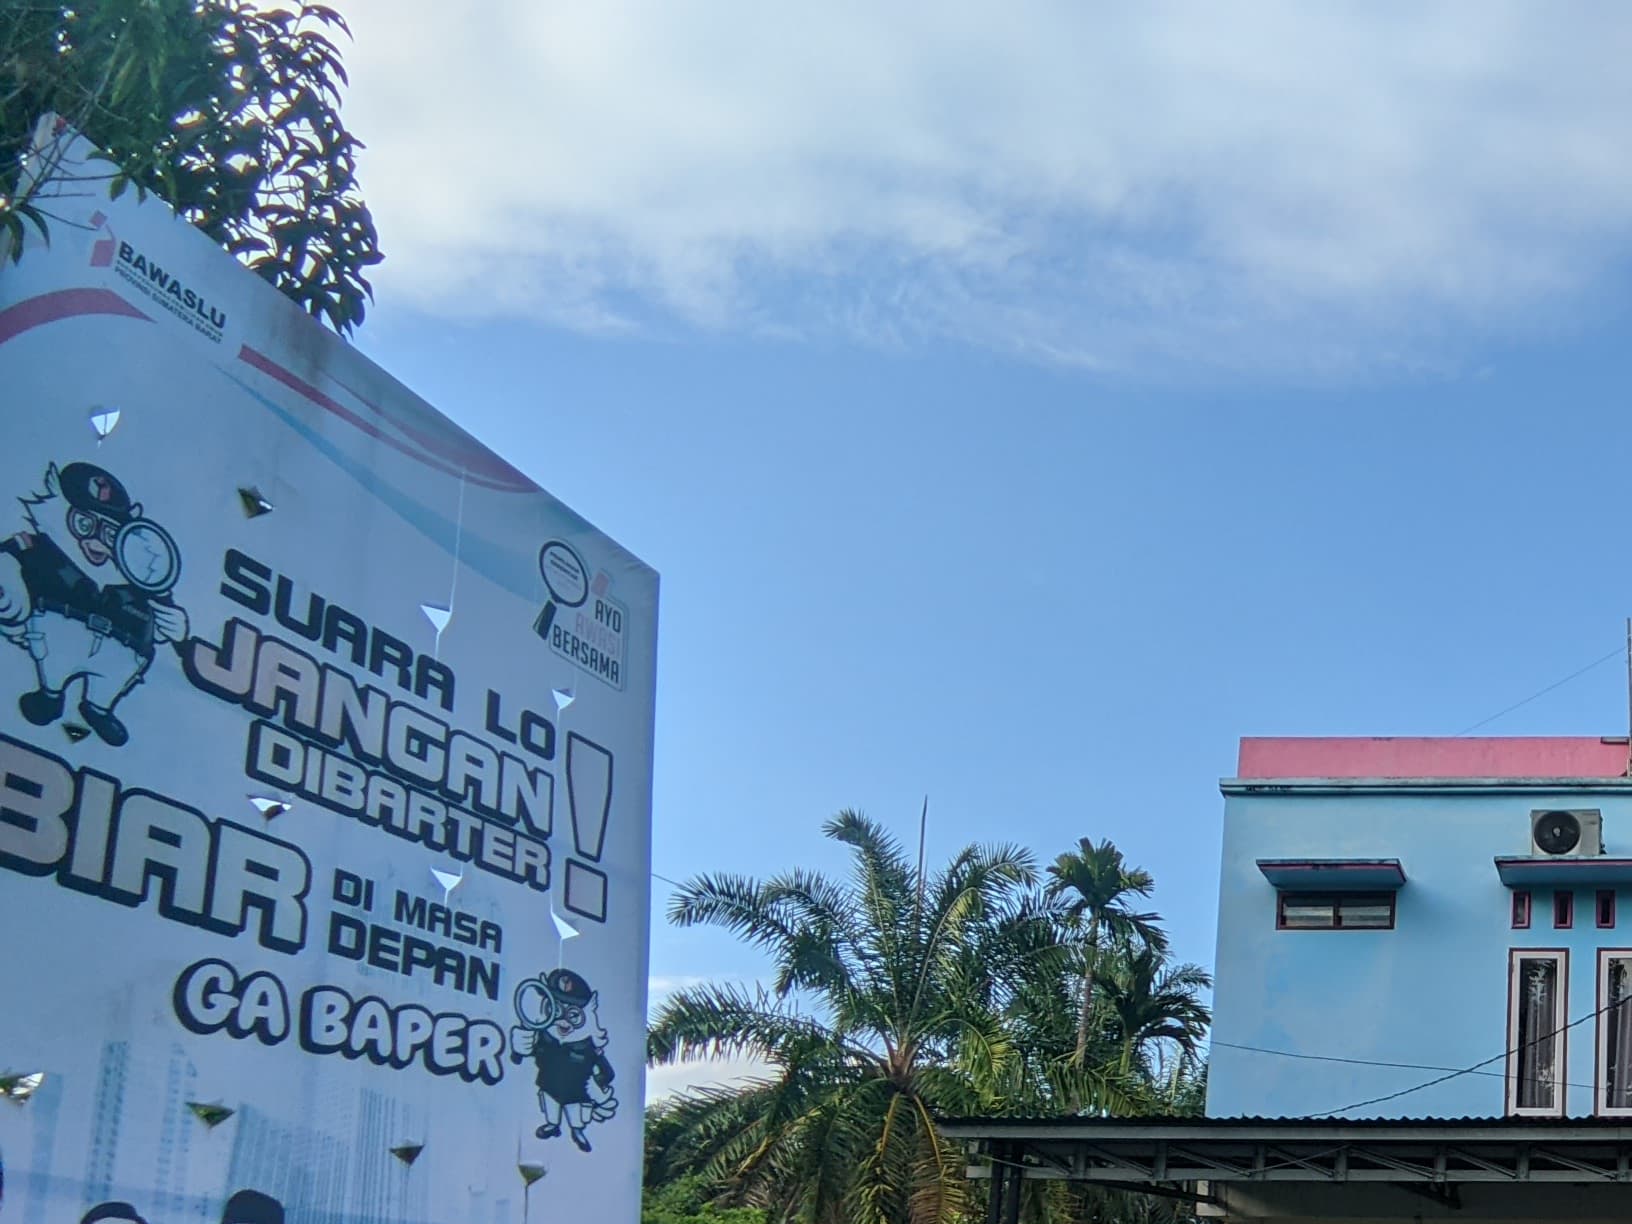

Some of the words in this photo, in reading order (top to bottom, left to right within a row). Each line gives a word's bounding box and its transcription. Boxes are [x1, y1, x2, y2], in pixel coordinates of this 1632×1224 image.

[117, 240, 226, 329] BAWASLU
[219, 548, 456, 712] SUARA
[485, 688, 556, 761] LO
[552, 624, 619, 684] BERSAMA
[595, 599, 622, 633] AYO
[181, 616, 555, 841] JANGAN
[0, 732, 312, 956] BIAR
[245, 718, 551, 892] DIBARTER
[327, 910, 500, 1001] DEPAN
[332, 867, 374, 912] DI
[394, 889, 503, 954] MASA
[172, 957, 291, 1046] GA
[299, 984, 506, 1086] BAPER
